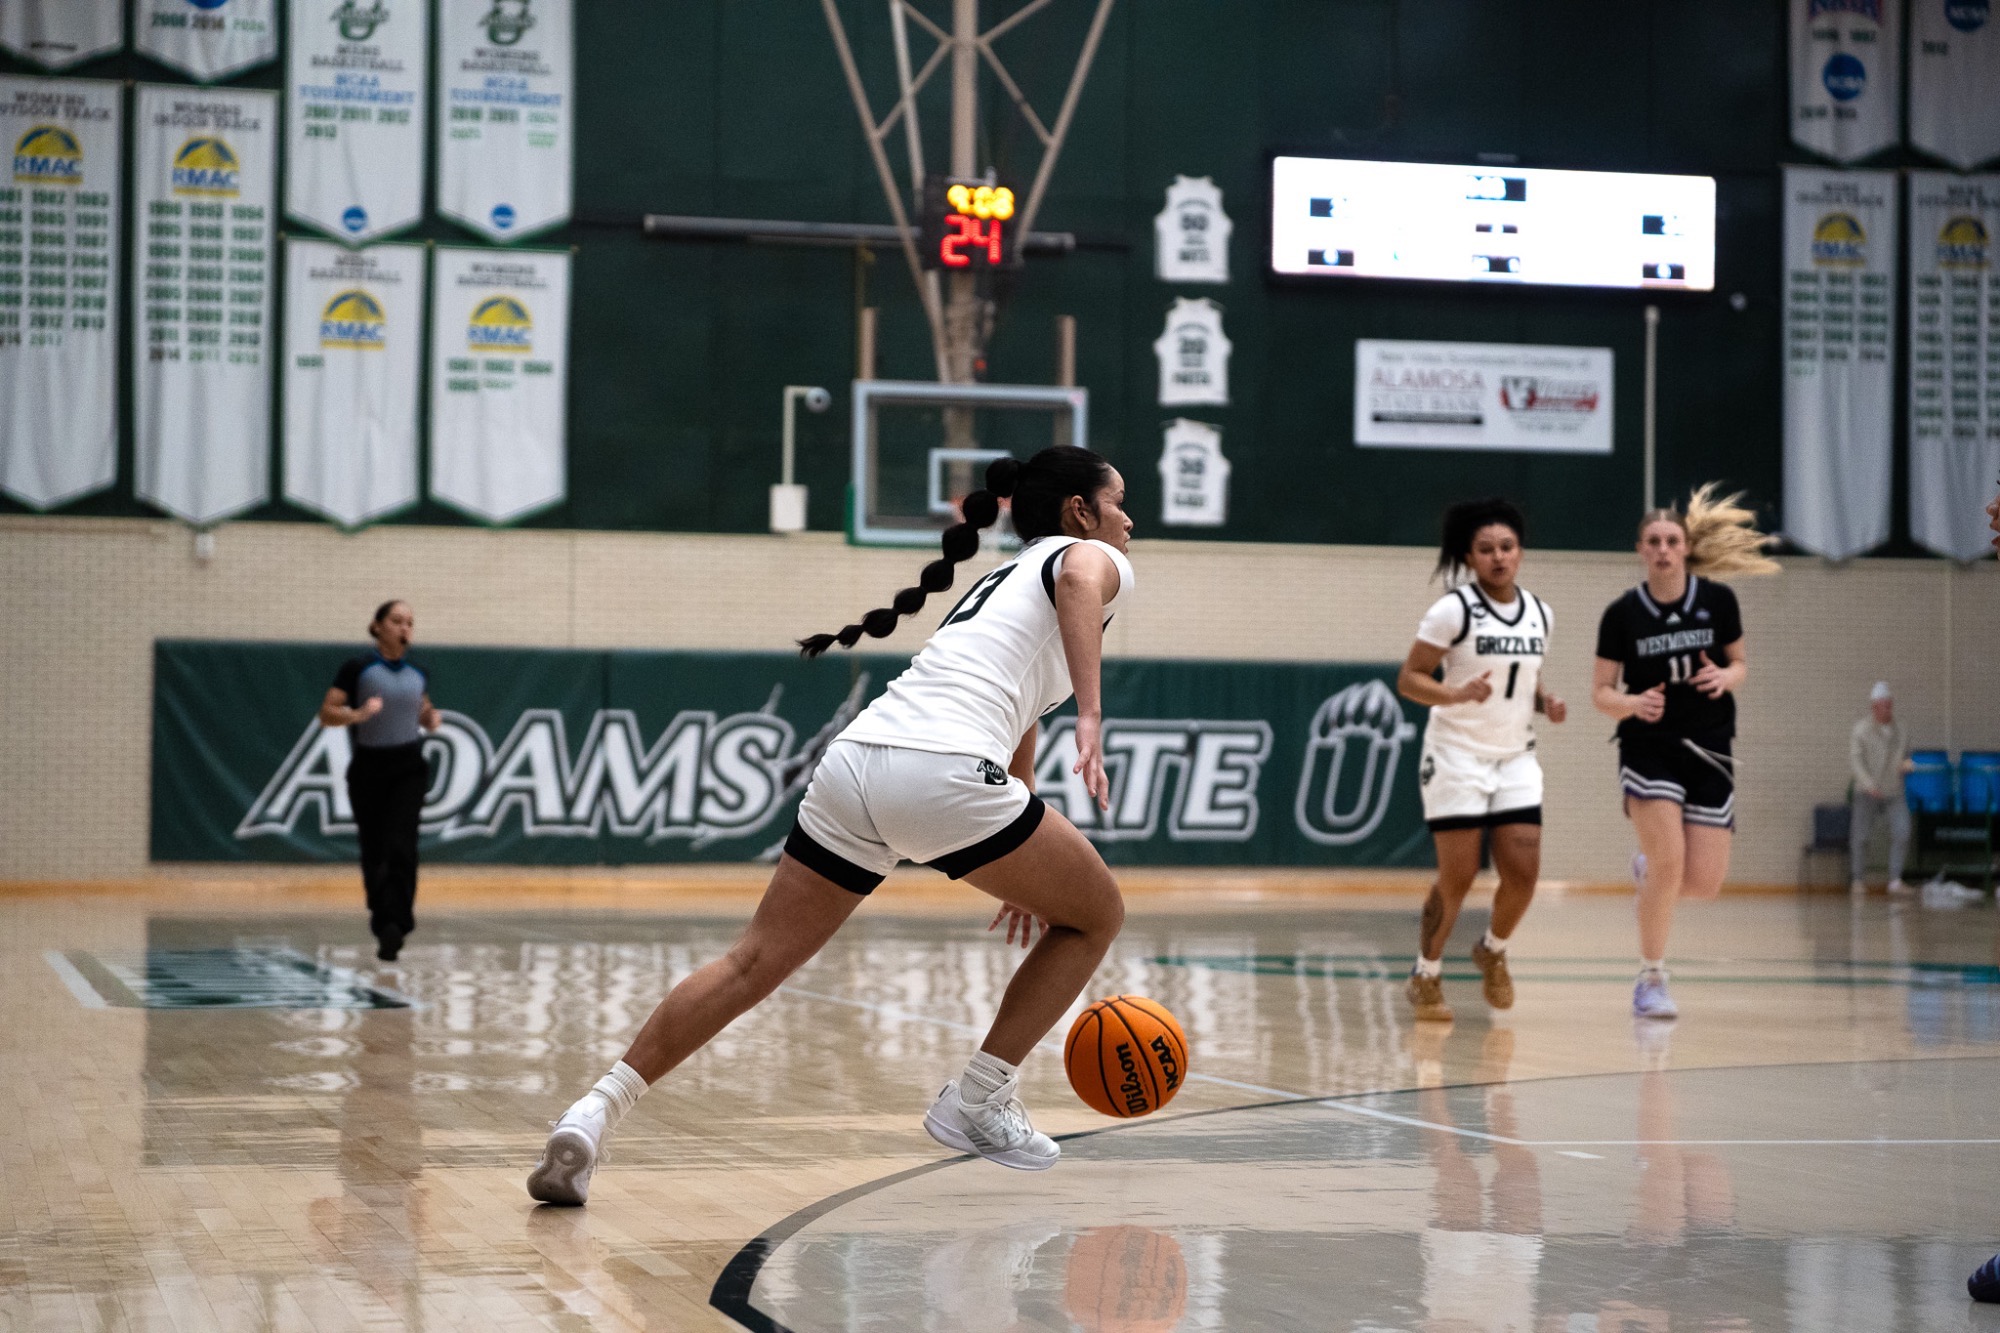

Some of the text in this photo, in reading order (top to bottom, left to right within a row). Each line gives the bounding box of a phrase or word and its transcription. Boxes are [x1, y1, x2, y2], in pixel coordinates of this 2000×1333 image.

[311, 55, 405, 71] BASKETBALL
[13, 157, 82, 177] RMAC
[172, 167, 239, 189] RMAC
[940, 213, 1003, 267] 24
[320, 321, 386, 341] RMAC
[467, 327, 533, 346] RMAC
[1371, 367, 1484, 389] ALAMOSA
[1476, 636, 1544, 656] GRIZZLIE
[1636, 628, 1715, 657] WESTMINSTER
[1504, 660, 1520, 699] 1
[1667, 654, 1693, 684] 11
[1036, 716, 1274, 842] ATE
[1150, 1034, 1180, 1093] NCAA
[1115, 1041, 1150, 1116] Wilson
